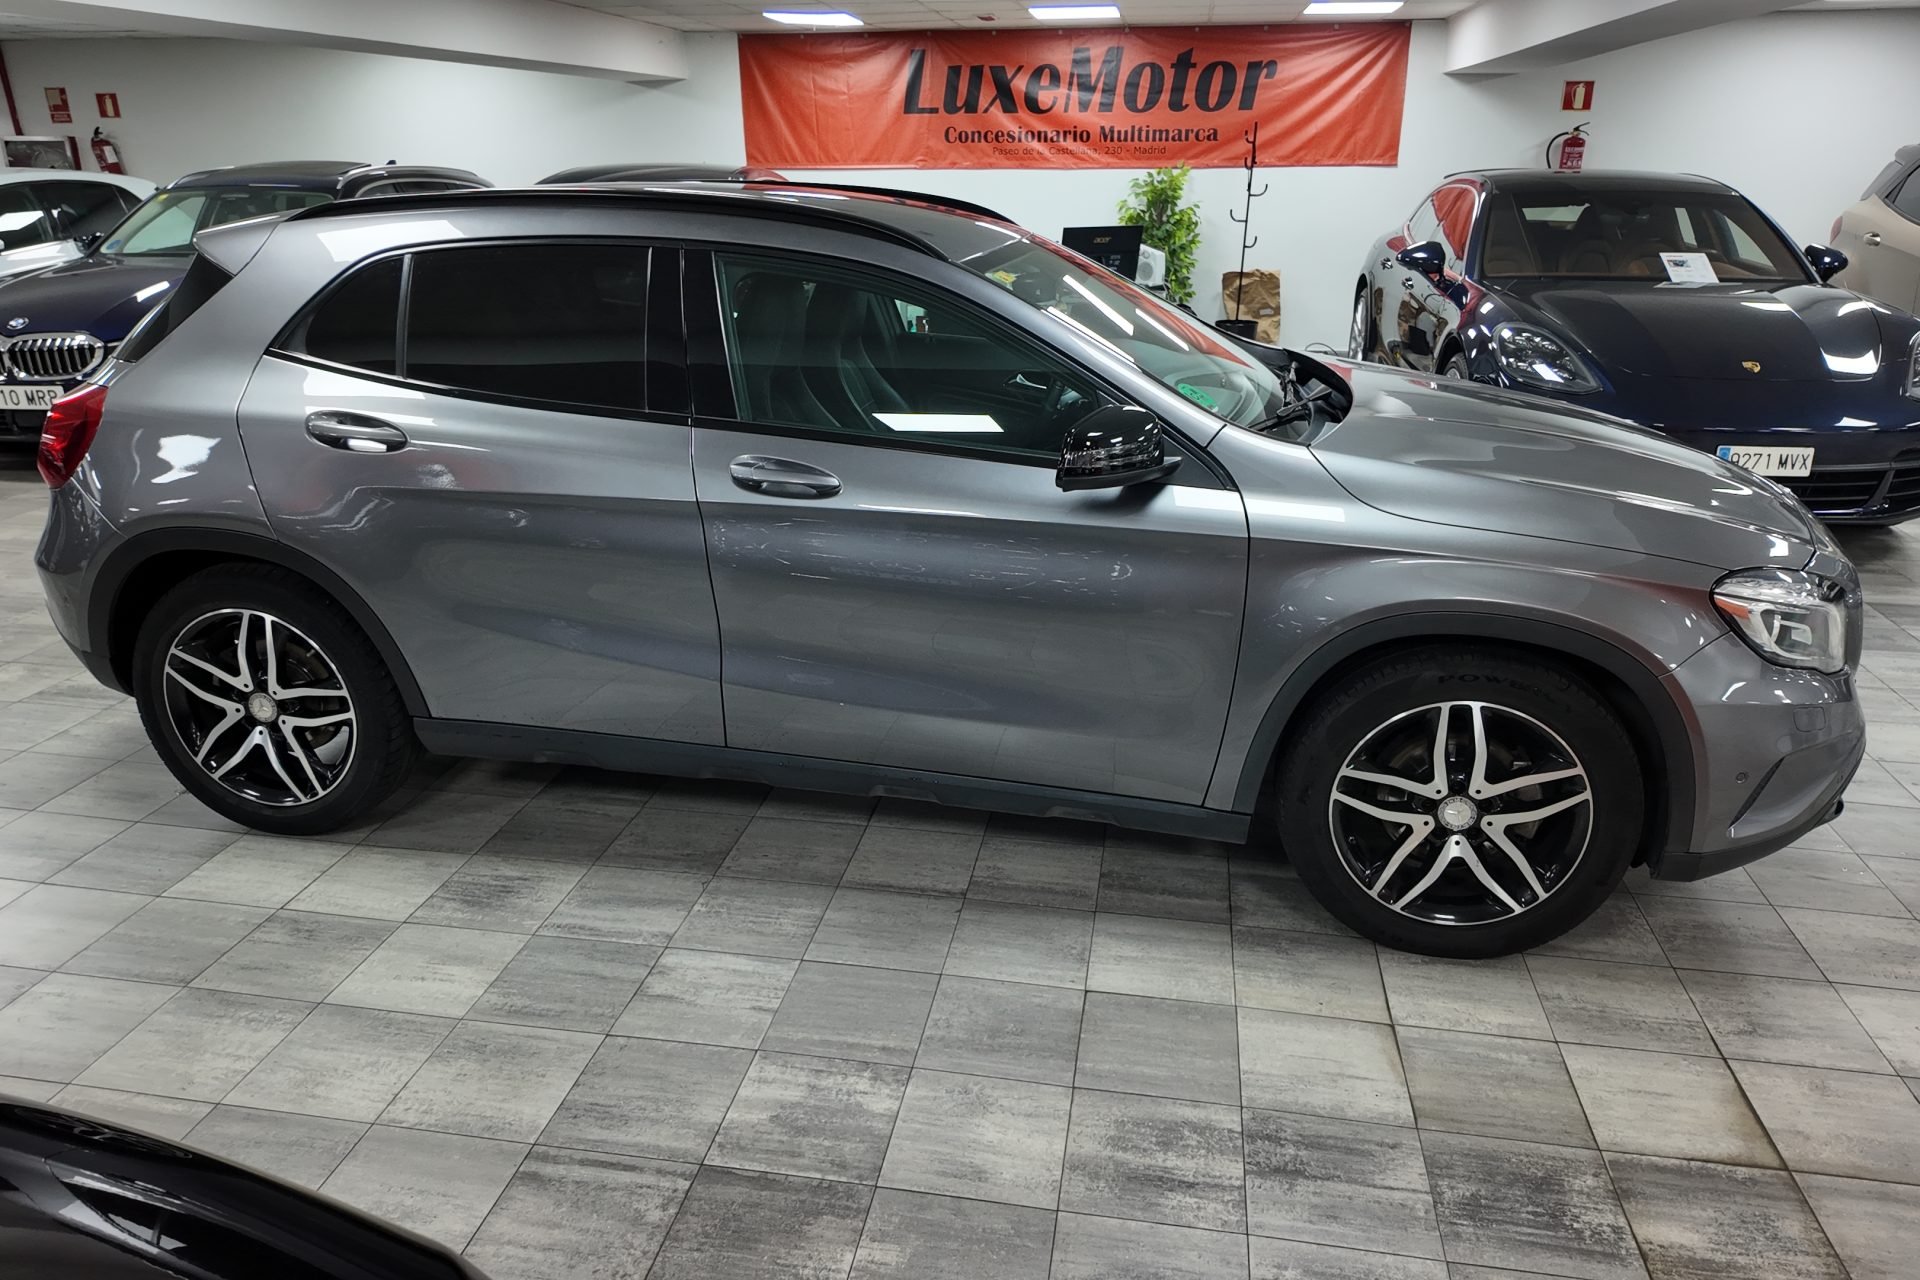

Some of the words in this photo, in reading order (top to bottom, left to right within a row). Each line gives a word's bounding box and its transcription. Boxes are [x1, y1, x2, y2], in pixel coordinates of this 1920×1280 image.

[903, 46, 1278, 114] LuxeMotor
[944, 125, 1091, 143] Concesionario
[1099, 125, 1219, 143] Multimarca
[992, 146, 1019, 155] Paseo
[1022, 146, 1034, 155] de
[1104, 146, 1123, 155] 230
[1133, 146, 1167, 155] Madrid
[1730, 452, 1772, 470] 9271
[1777, 453, 1811, 470] MVX
